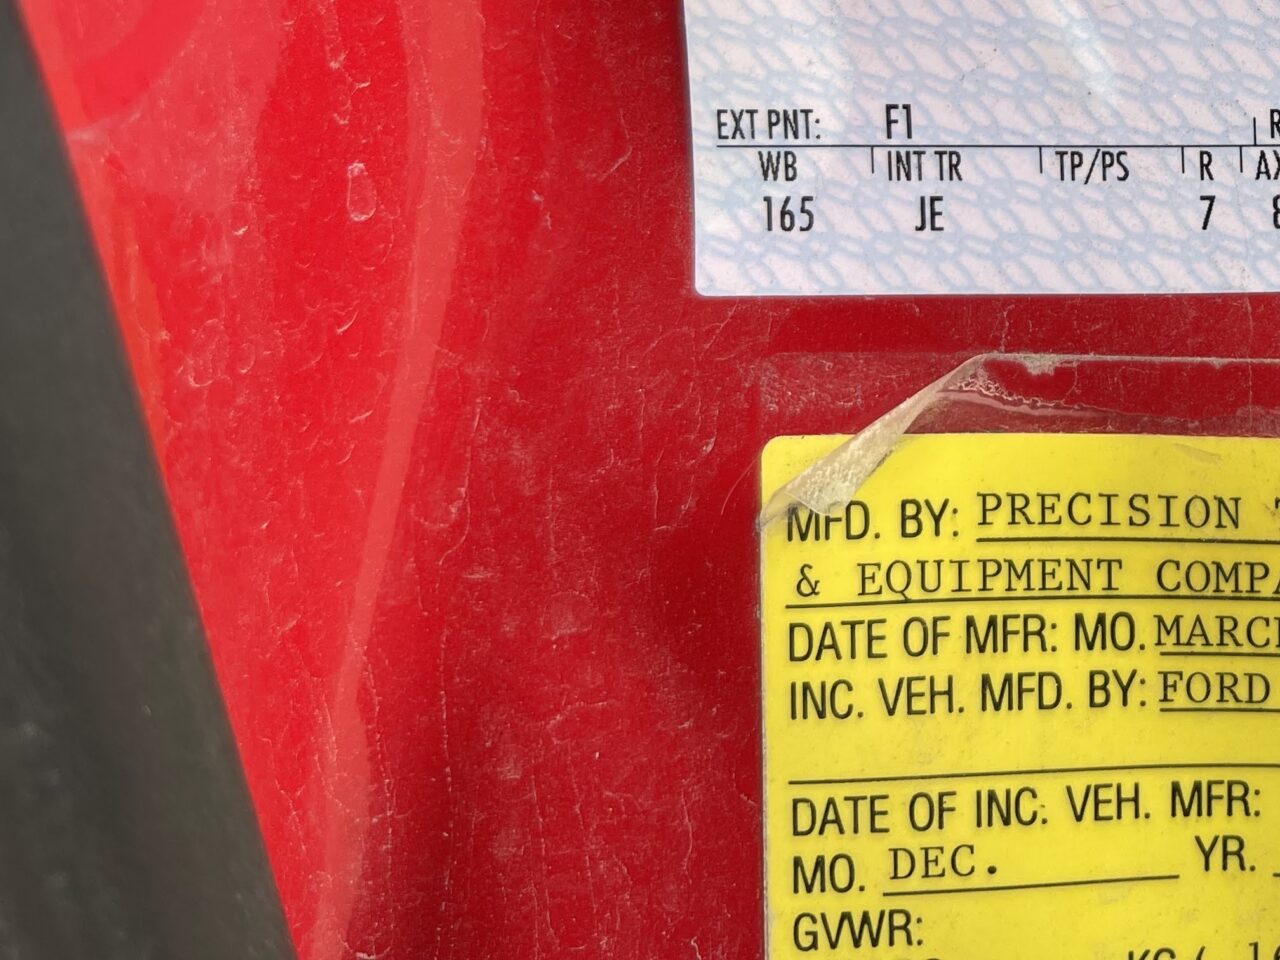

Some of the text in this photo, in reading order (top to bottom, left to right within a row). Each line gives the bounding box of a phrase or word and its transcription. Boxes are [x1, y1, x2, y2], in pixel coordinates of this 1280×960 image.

[716, 103, 914, 140] EXT PNT: F1
[758, 150, 798, 182] WB
[887, 151, 963, 182] INT TR
[1055, 149, 1130, 186] TP/PS
[1199, 150, 1214, 182] R
[762, 195, 815, 233] 165
[914, 196, 945, 233] JE
[1199, 195, 1217, 232] 7
[900, 497, 960, 539] BY:
[976, 492, 1242, 529] PRECISION
[796, 563, 821, 598] &
[856, 558, 1123, 601] EQUIPMENT
[788, 619, 888, 663] DATE
[902, 614, 952, 658] OF
[965, 613, 1058, 655] MFR:
[1073, 611, 1146, 652] MO.
[790, 678, 864, 721] INC.
[877, 674, 965, 718] VEH.
[980, 671, 1073, 713] MFD.
[1088, 669, 1147, 710] BY:
[1157, 671, 1271, 704] FORD
[791, 794, 890, 837] DATE
[908, 790, 957, 832] OF
[1065, 782, 1151, 823] VEH.
[1170, 778, 1262, 819] MFR:
[792, 853, 866, 894] MO.
[888, 844, 998, 881] DEC.
[1194, 834, 1257, 873] YR.
[793, 908, 924, 952] GVWR:
